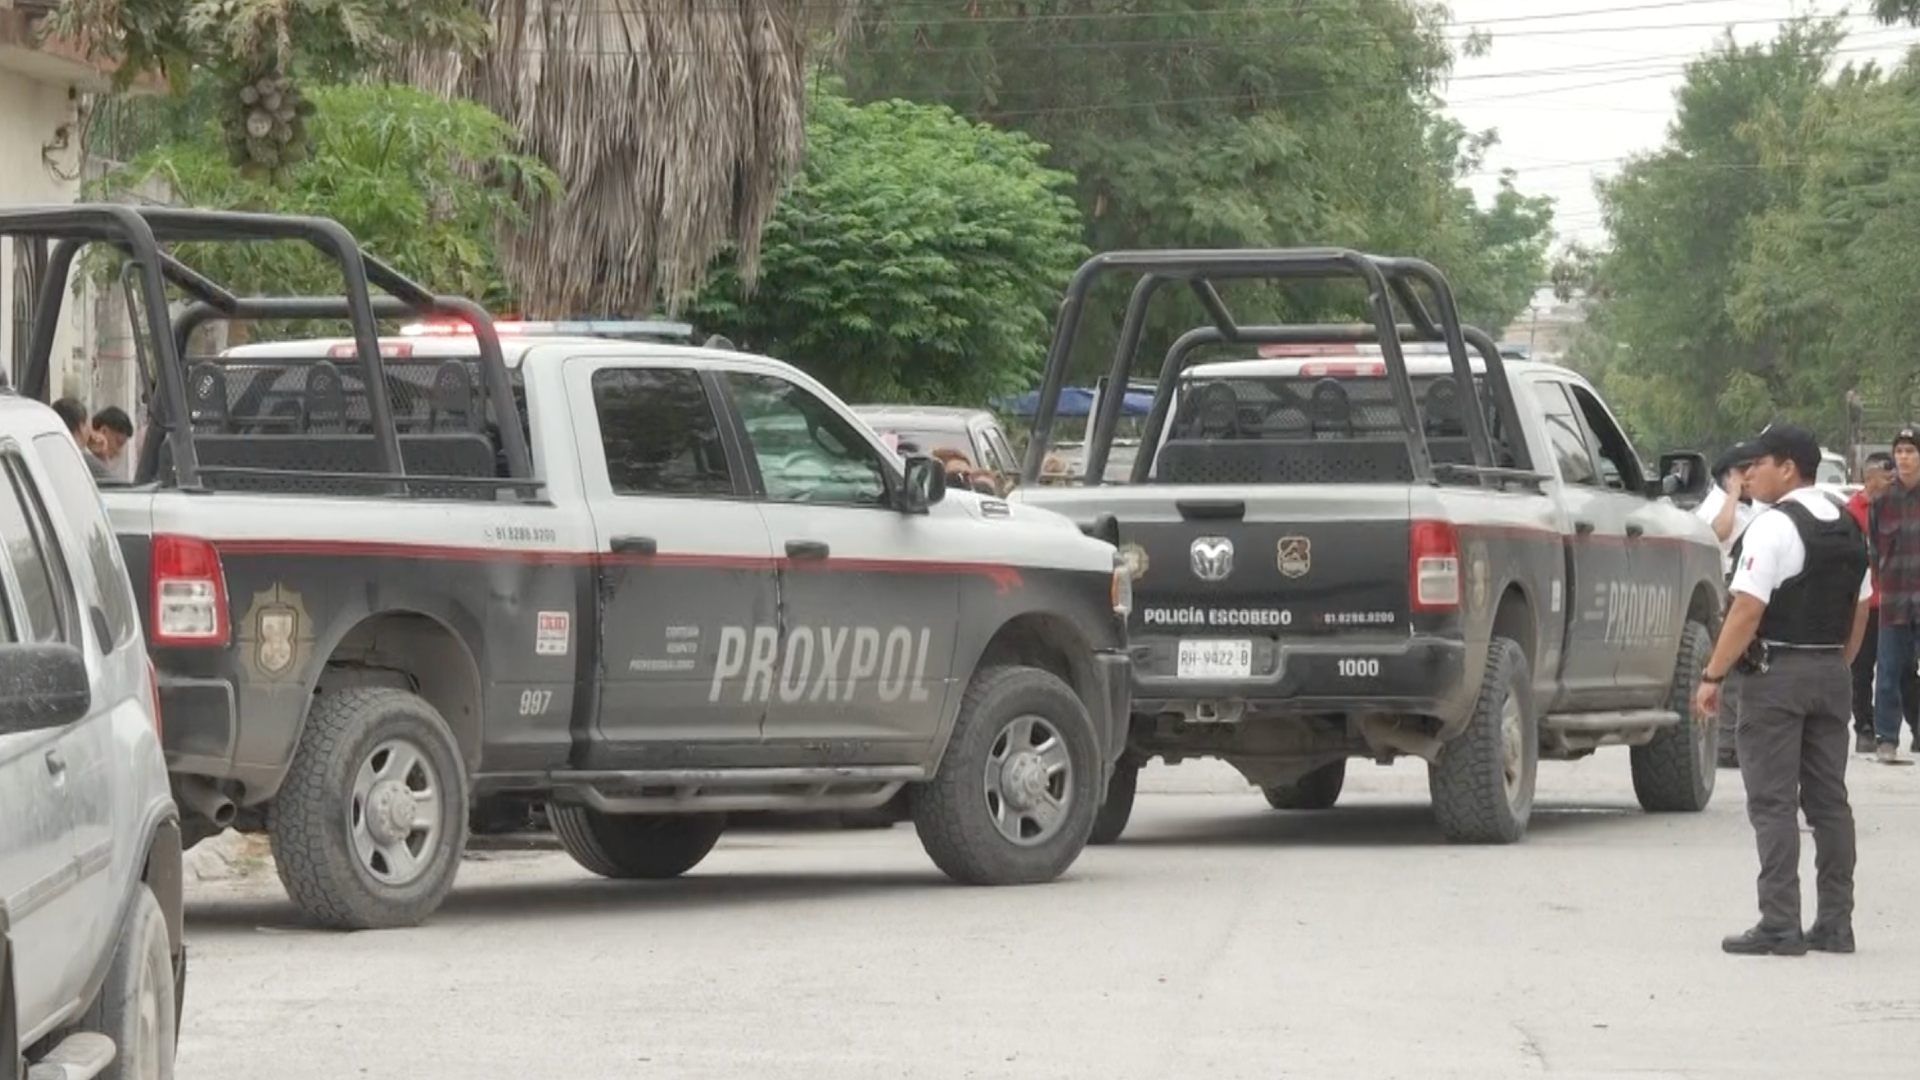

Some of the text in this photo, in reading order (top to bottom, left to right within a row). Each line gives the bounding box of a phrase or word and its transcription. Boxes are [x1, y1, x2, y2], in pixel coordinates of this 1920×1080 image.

[1144, 606, 1292, 625] POLICÍA ESCOBEDO
[708, 625, 931, 702] PROXPOL
[1337, 659, 1379, 677] 1000
